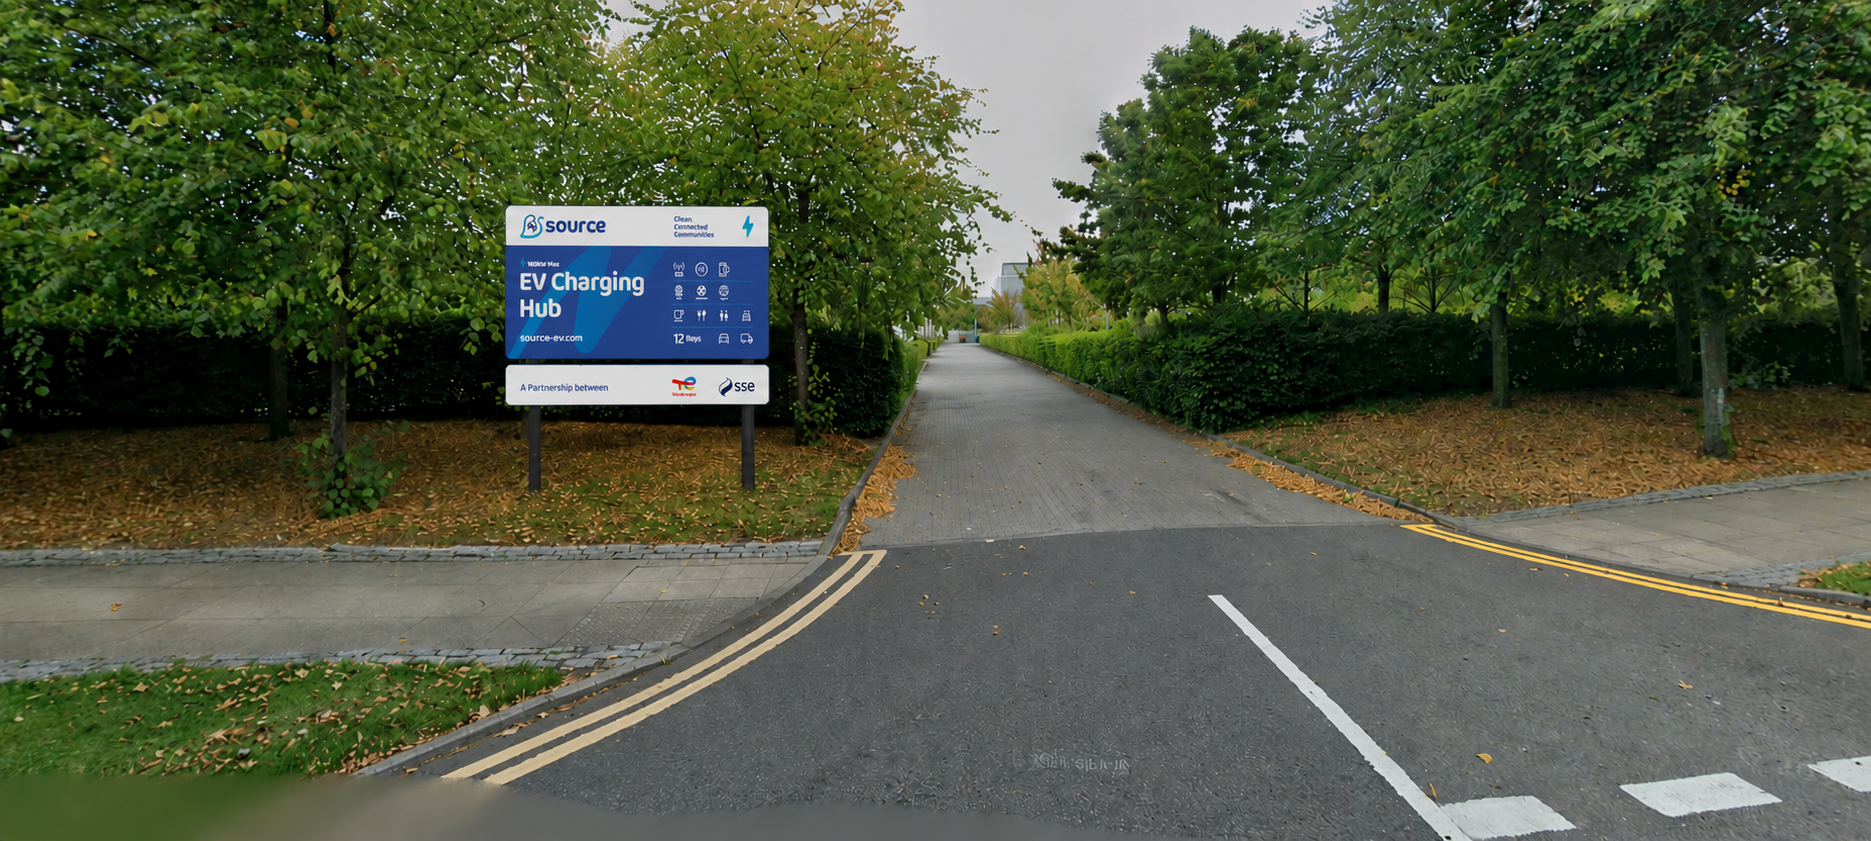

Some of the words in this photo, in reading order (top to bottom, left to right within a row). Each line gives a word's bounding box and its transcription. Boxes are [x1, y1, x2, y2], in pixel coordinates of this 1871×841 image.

[545, 220, 606, 232] source
[520, 272, 547, 291] EV
[551, 271, 644, 296] Charging
[520, 298, 562, 318] Hub
[520, 334, 583, 342] source-ev.com
[673, 333, 685, 344] 12
[685, 335, 702, 343] Bays
[520, 384, 526, 392] A
[528, 383, 573, 393] Partnership
[574, 383, 609, 392] between
